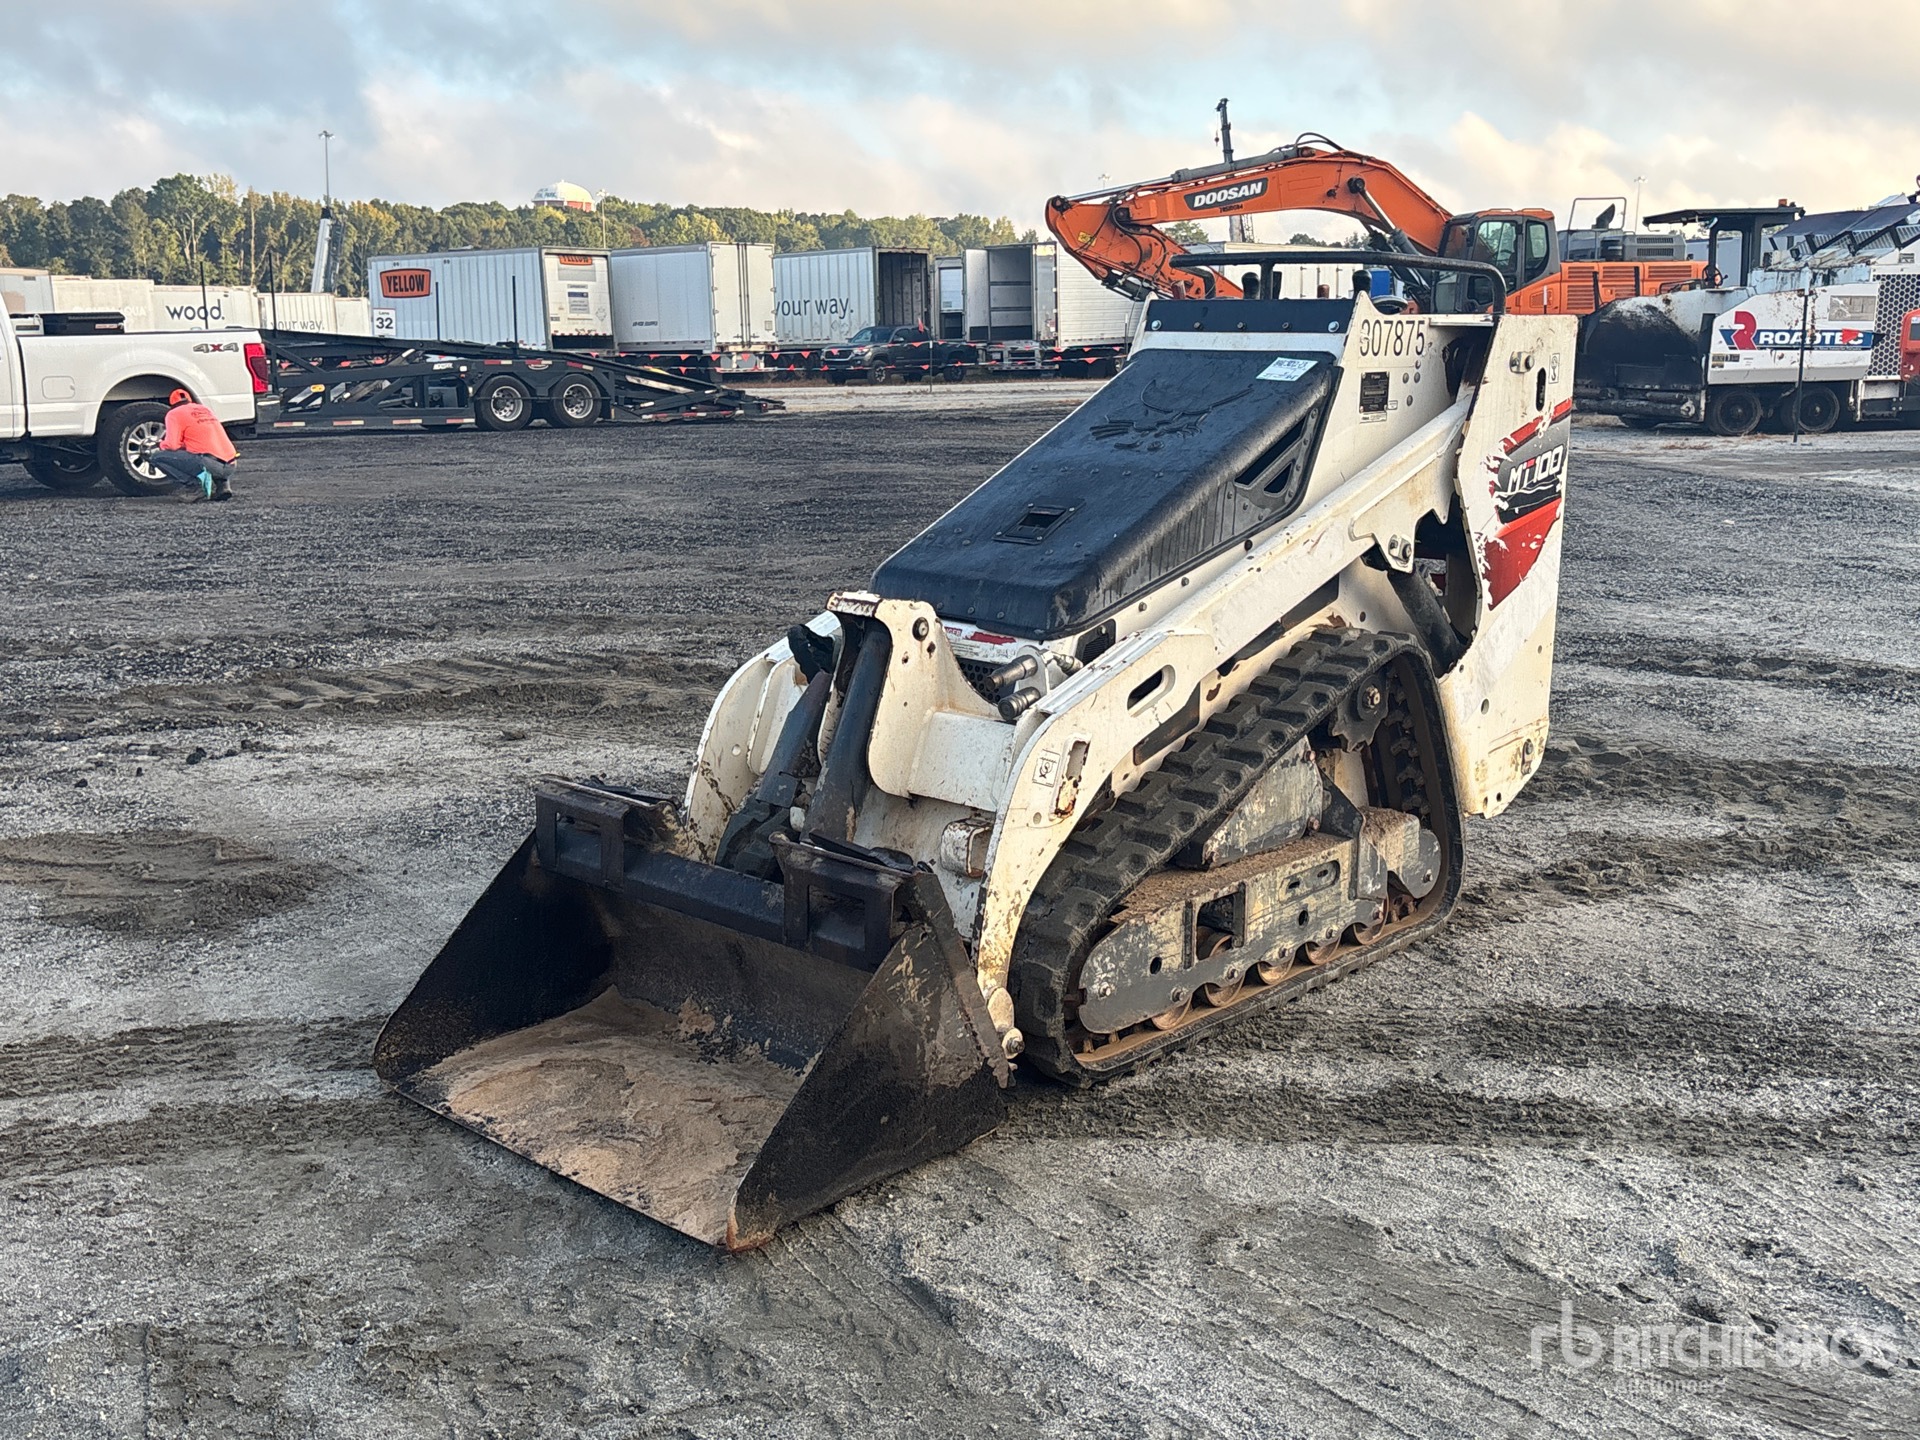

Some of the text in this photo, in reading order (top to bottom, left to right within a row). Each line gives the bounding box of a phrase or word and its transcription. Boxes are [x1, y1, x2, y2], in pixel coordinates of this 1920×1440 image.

[1194, 182, 1263, 208] DOOSAN
[386, 274, 425, 293] YELLOW
[166, 299, 225, 320] wood.
[815, 298, 854, 319] way.
[376, 317, 394, 330] 32
[1360, 319, 1425, 357] 307875
